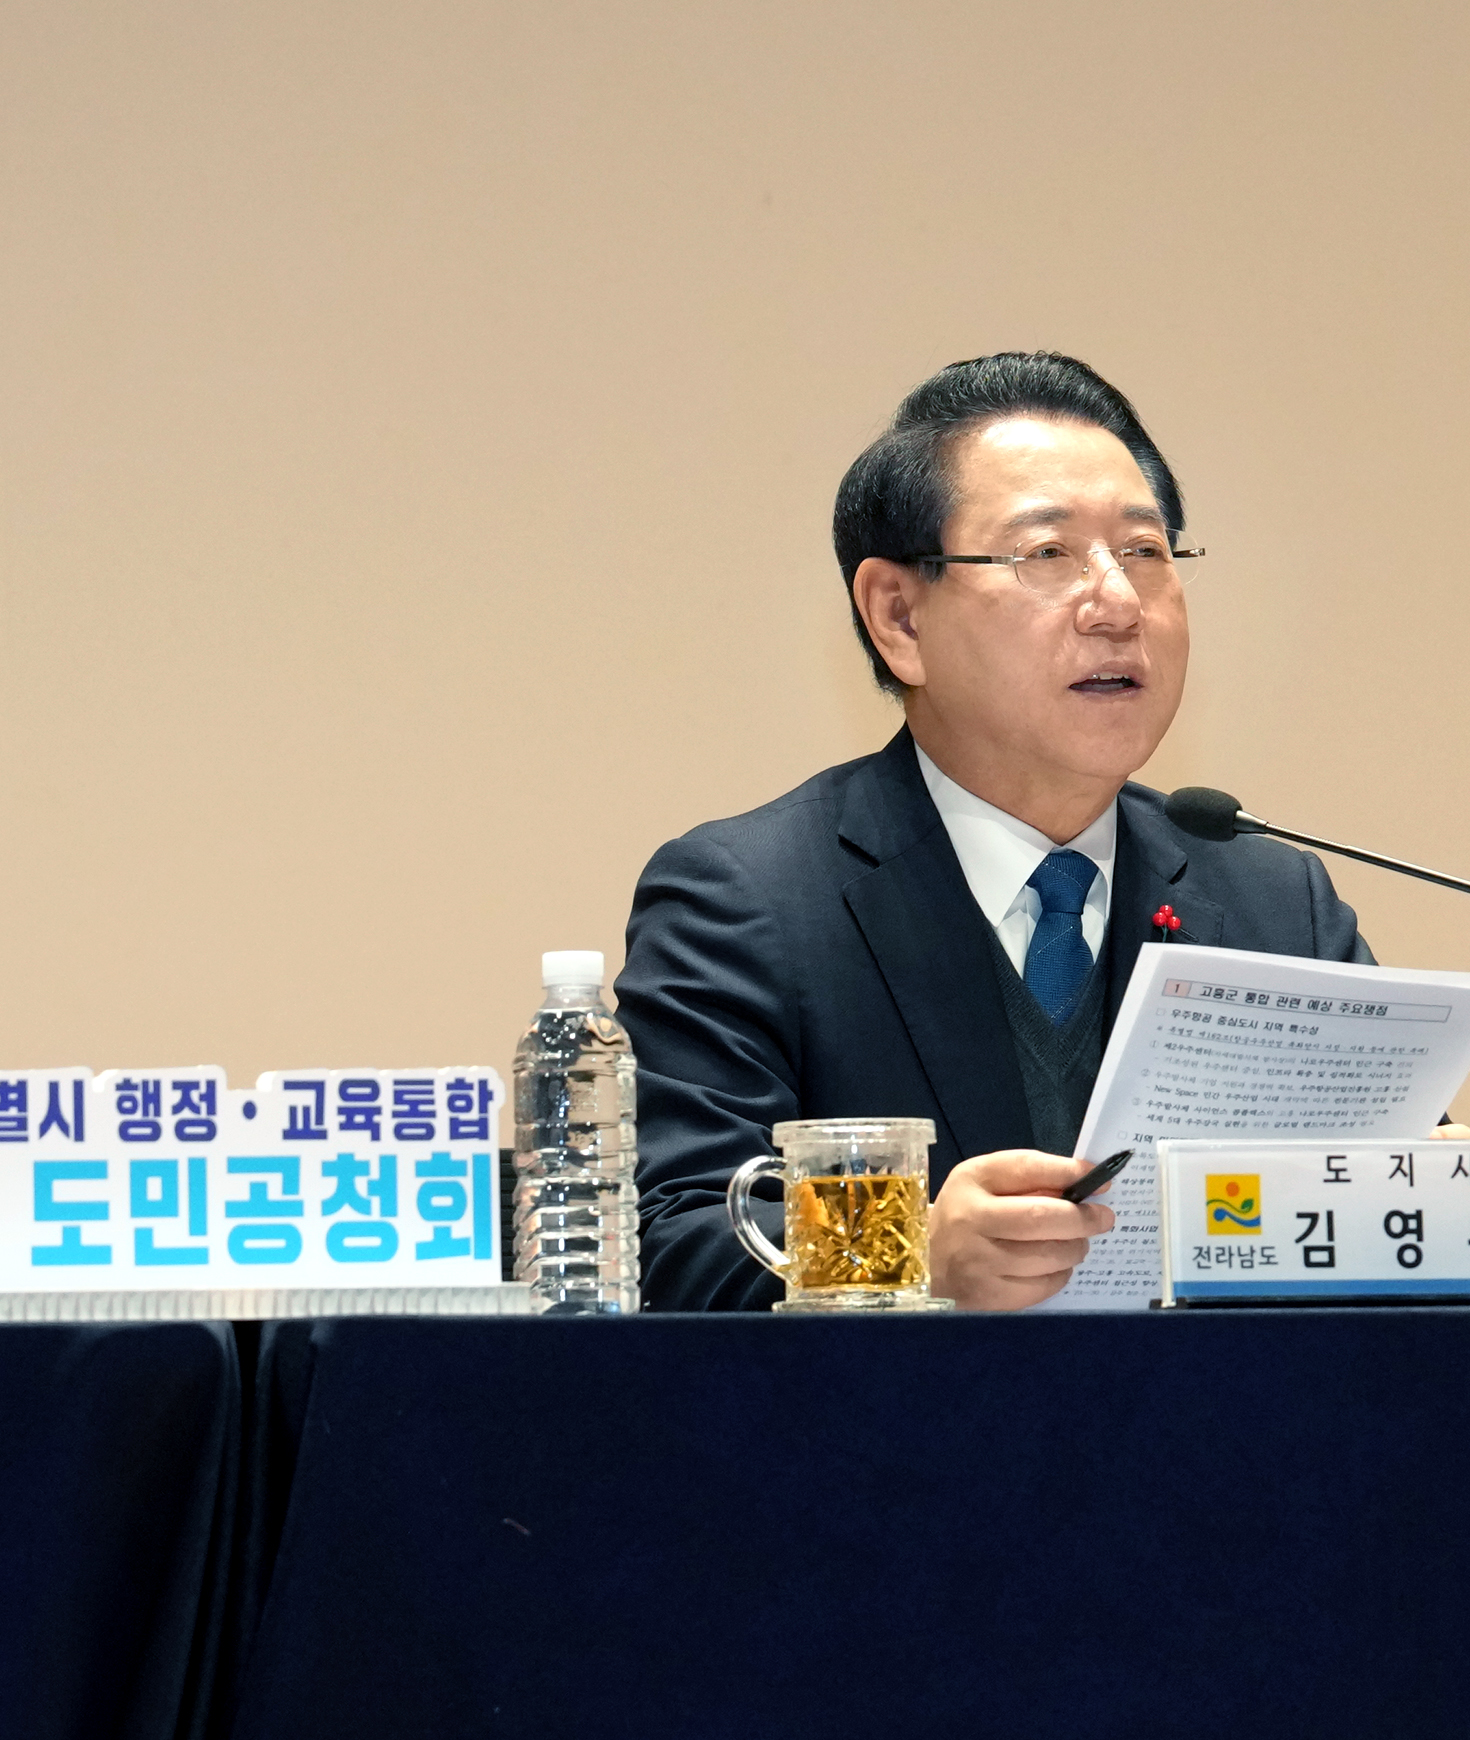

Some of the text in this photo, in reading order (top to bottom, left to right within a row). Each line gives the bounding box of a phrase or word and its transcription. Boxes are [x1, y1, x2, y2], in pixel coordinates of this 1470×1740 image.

[1174, 983, 1389, 1017] 1 고흥군 통합 관련 예상 주요쟁점
[1171, 1008, 1320, 1036] 우주항공 중심도시 지역 특수성
[1154, 1084, 1172, 1094] New
[1175, 1087, 1199, 1098] Space
[0, 1079, 85, 1142] 별시
[1133, 1133, 1153, 1143] 지역
[31, 1151, 493, 1266] 도민공청회
[1120, 1225, 1159, 1233] 특화사업
[1192, 1246, 1279, 1270] 전라남도
